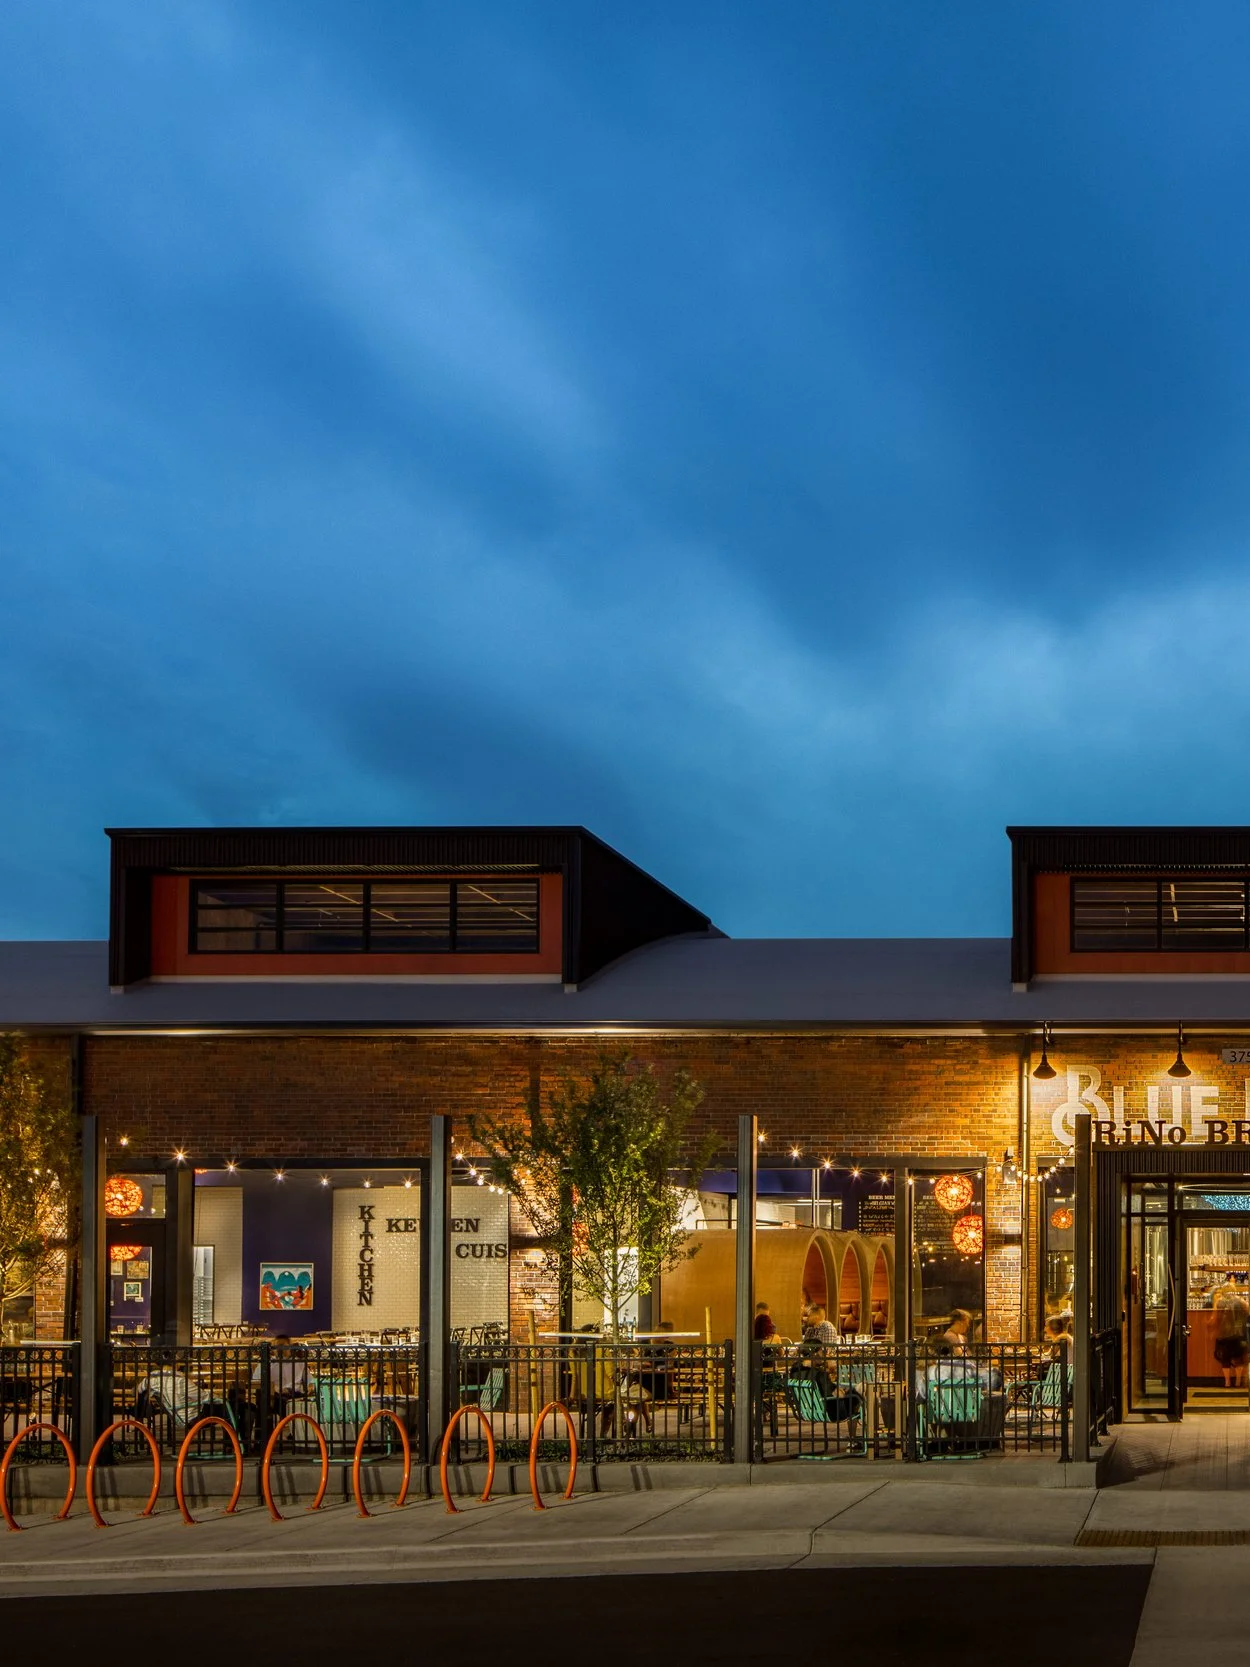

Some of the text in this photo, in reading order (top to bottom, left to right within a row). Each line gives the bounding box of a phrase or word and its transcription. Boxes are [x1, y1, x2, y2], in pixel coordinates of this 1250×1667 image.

[1052, 1065, 1219, 1147] BLUE
[1092, 1120, 1187, 1145] RiNo
[357, 1206, 375, 1306] KITCHEN
